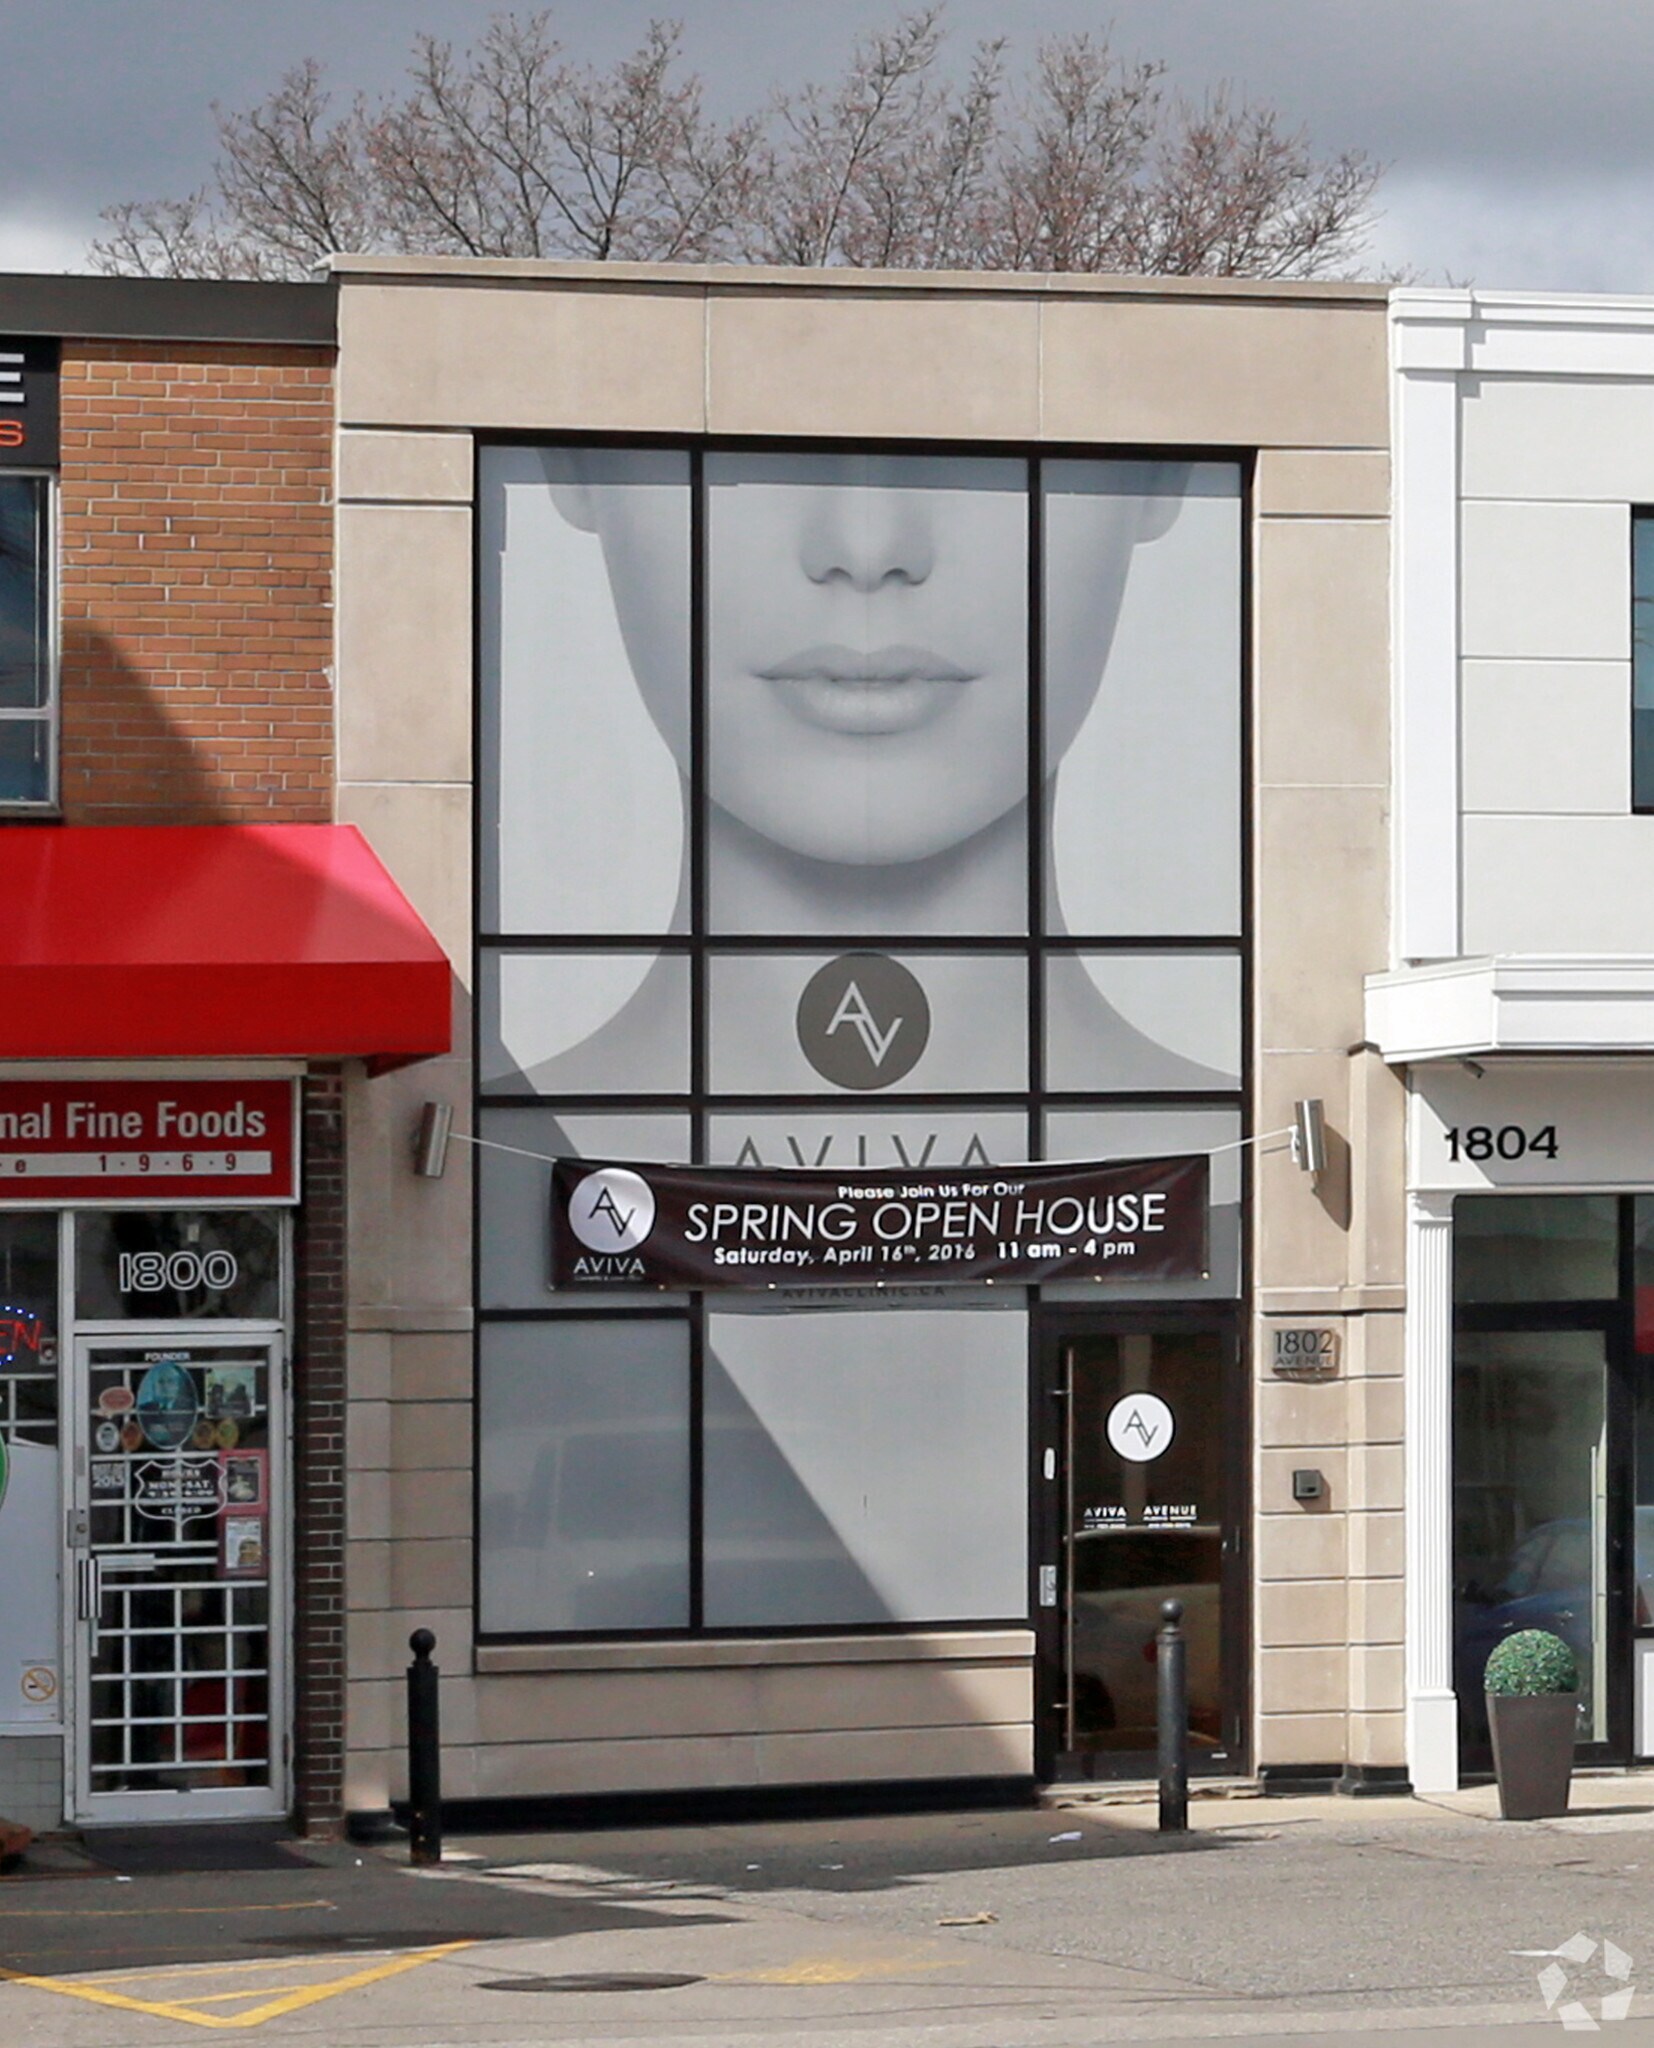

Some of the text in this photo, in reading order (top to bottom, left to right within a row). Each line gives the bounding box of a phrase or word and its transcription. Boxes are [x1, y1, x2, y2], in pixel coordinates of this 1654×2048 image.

[66, 1102, 143, 1139] Fine
[157, 1100, 267, 1139] Foods
[1444, 1125, 1559, 1162] 1804
[838, 1181, 1025, 1199] Please Join Us For Our
[684, 1192, 1167, 1241] SPRING OPEN HOUSE
[573, 1256, 646, 1275] AVIVA
[714, 1247, 814, 1267] Saturday,
[823, 1246, 872, 1266] April
[928, 1243, 976, 1262] 2016
[998, 1241, 1019, 1260] 11
[1026, 1243, 1061, 1259] am
[1083, 1238, 1097, 1256] 4
[1103, 1241, 1136, 1260] pm
[119, 1250, 238, 1292] 1800
[1275, 1329, 1334, 1354] 1802
[1084, 1504, 1197, 1517] AVIVA AVENUE
